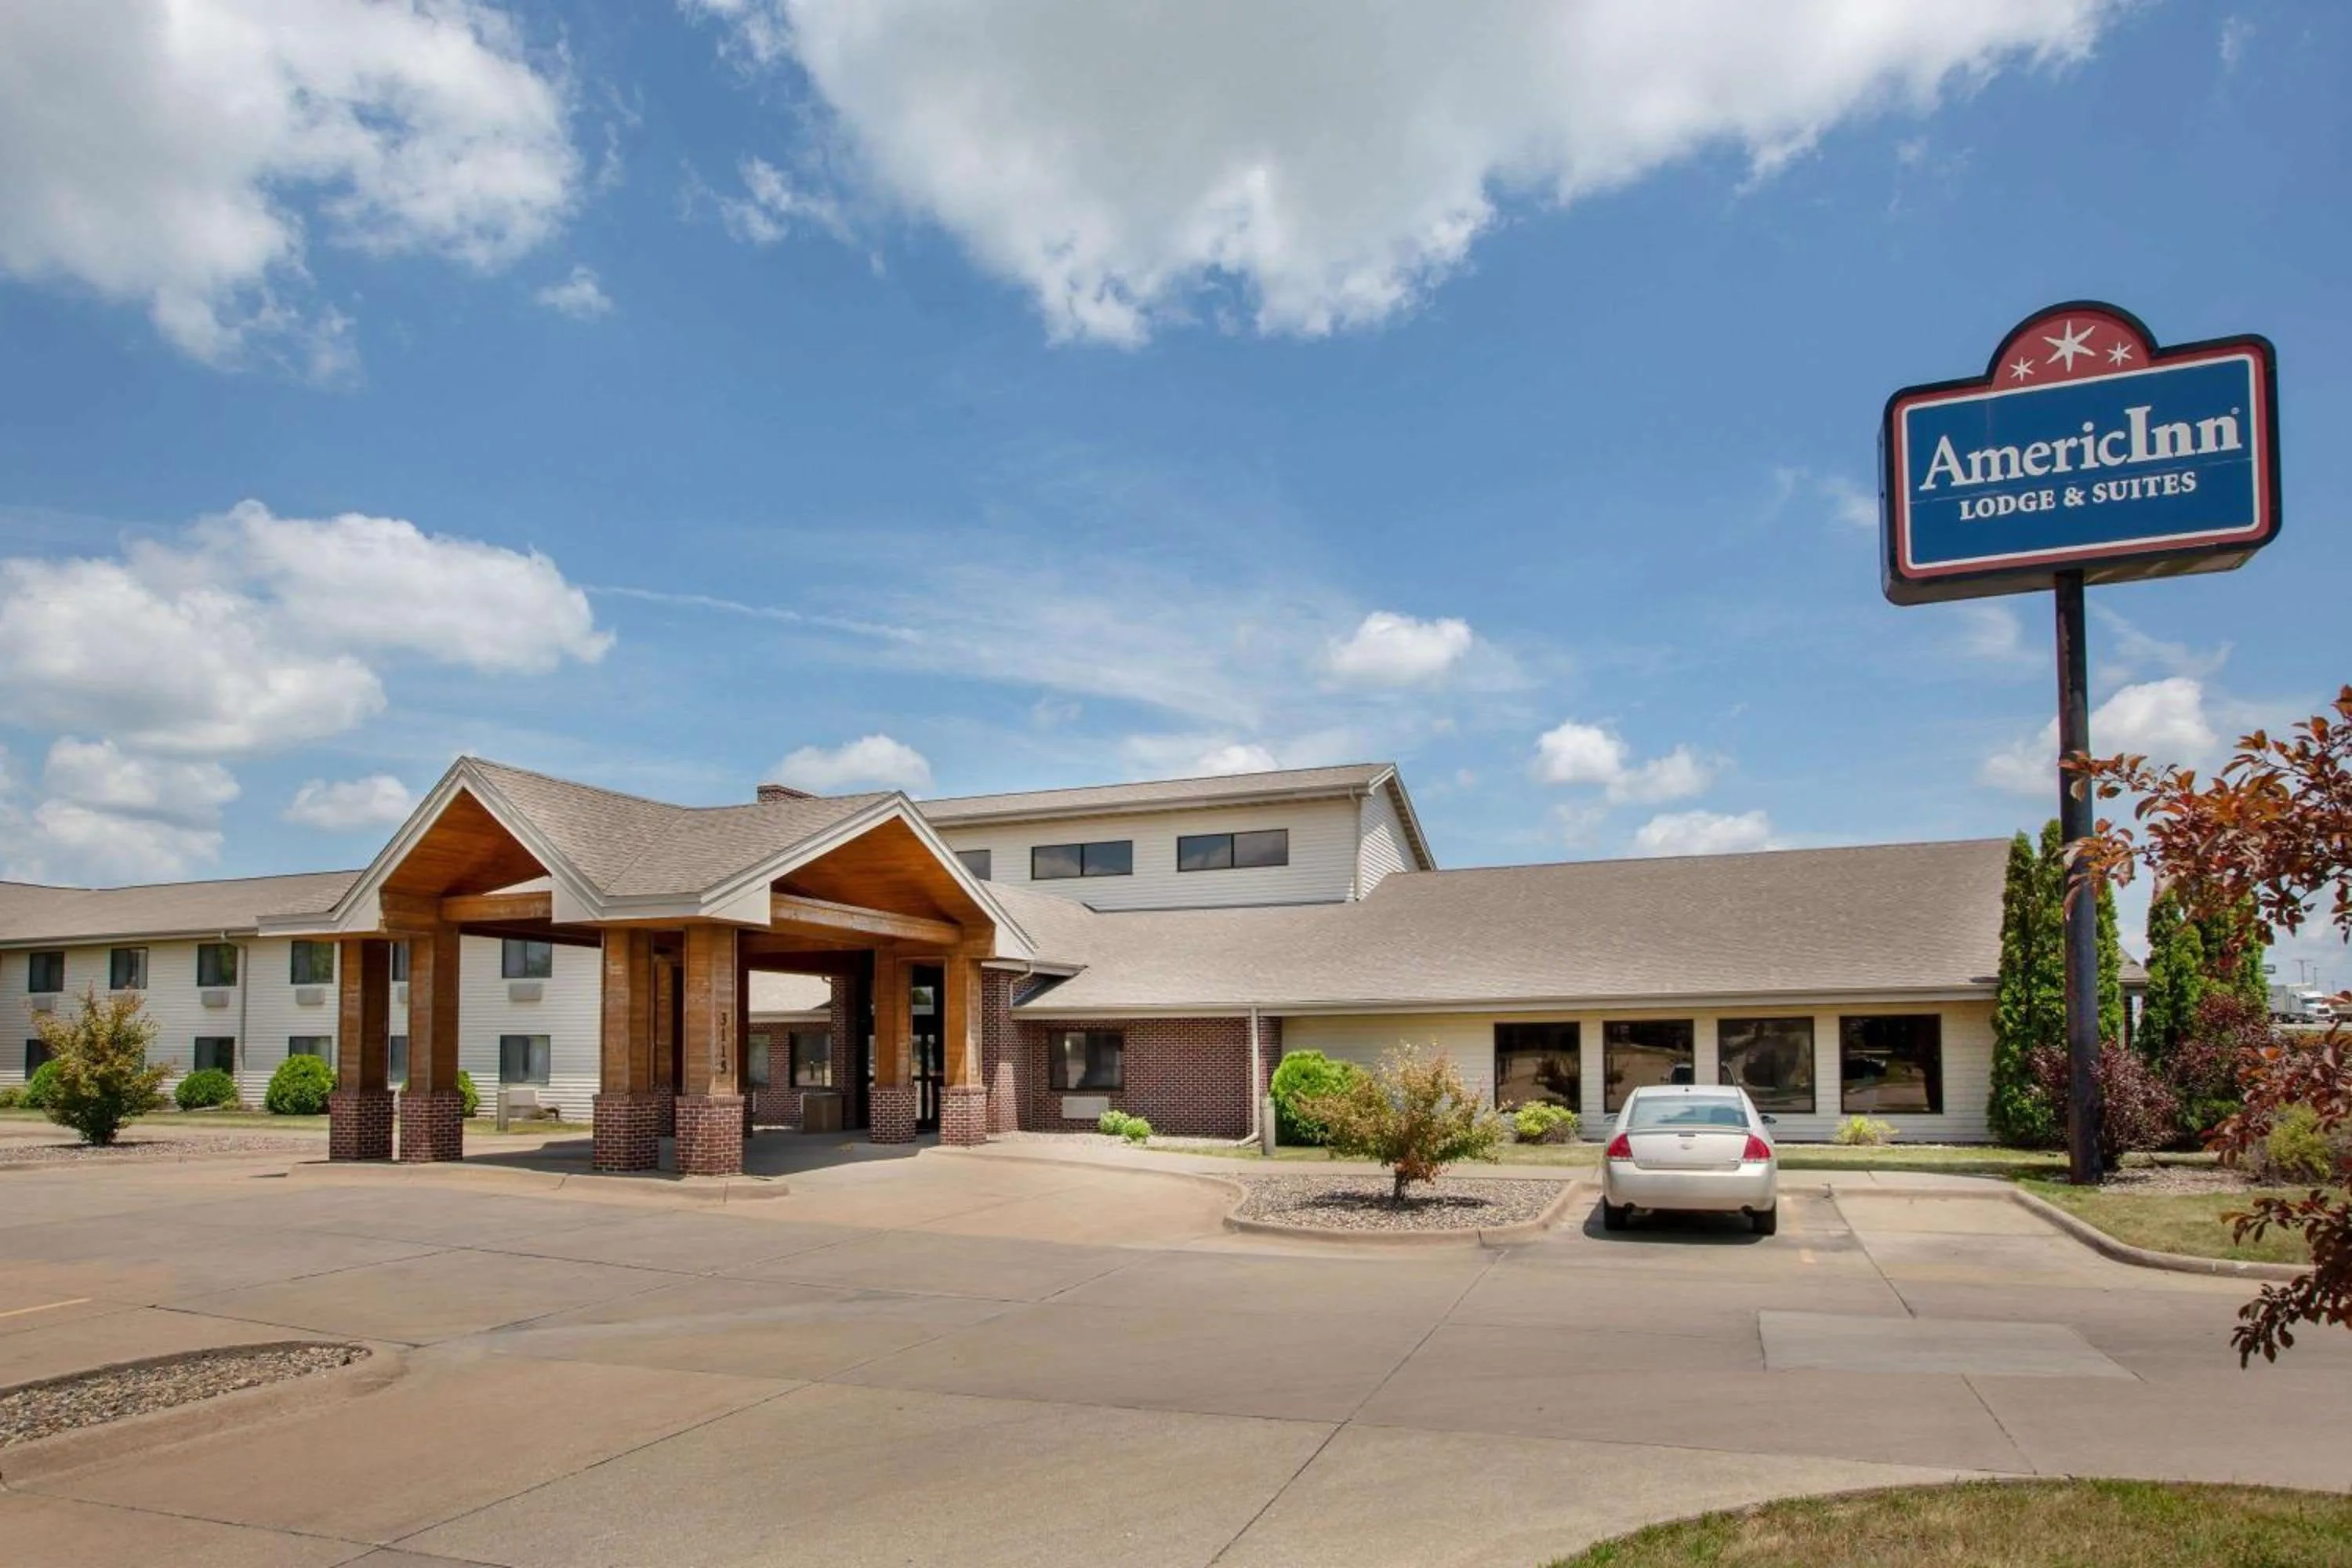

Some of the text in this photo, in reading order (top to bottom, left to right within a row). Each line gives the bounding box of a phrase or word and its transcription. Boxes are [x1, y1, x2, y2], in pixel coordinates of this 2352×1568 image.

[1919, 405, 2241, 491] AmericInn
[1959, 471, 2198, 521] LODGE & SUITES
